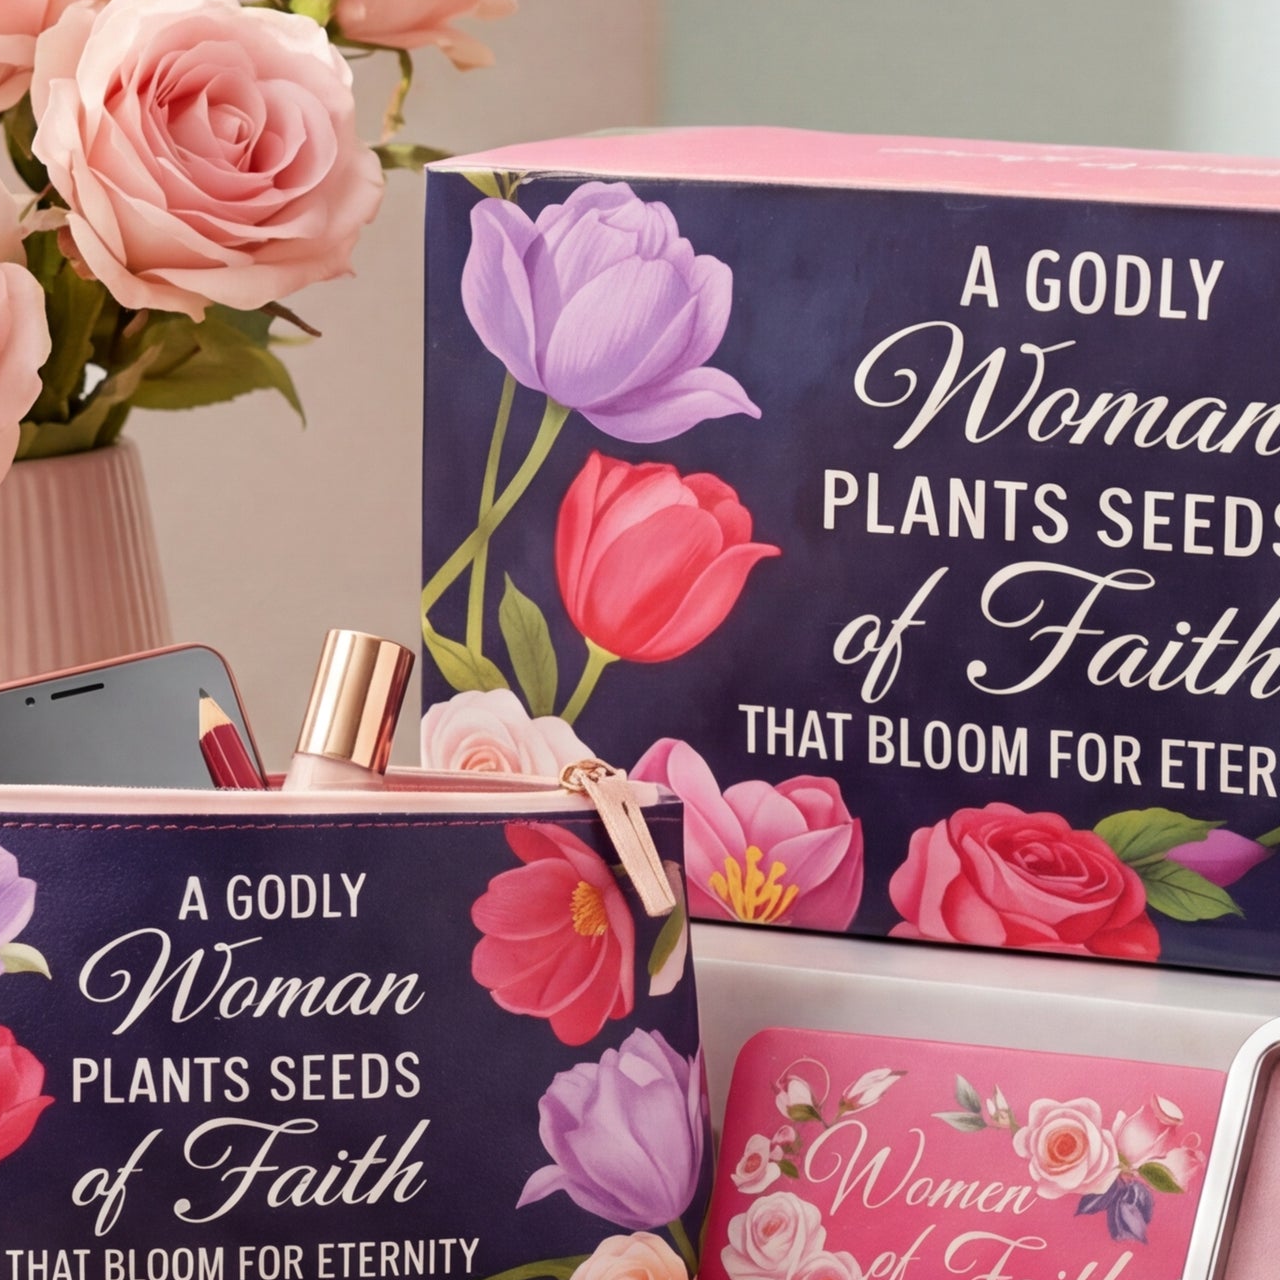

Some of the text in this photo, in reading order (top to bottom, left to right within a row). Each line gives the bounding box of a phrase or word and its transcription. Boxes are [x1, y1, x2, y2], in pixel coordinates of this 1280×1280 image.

[958, 244, 1226, 322] A GODLY
[822, 468, 1070, 545] PLANTS
[832, 565, 950, 705] of
[737, 703, 854, 762] THAT
[867, 713, 1029, 777] BLOOM
[1049, 728, 1143, 787] FOR
[177, 871, 368, 922] A GODLY
[77, 926, 426, 1036] Woman
[71, 1050, 421, 1104] PLANTS SEEDS
[70, 1116, 432, 1238] of Faith
[803, 1119, 1039, 1217] Women
[317, 1236, 481, 1280] ETERNITY
